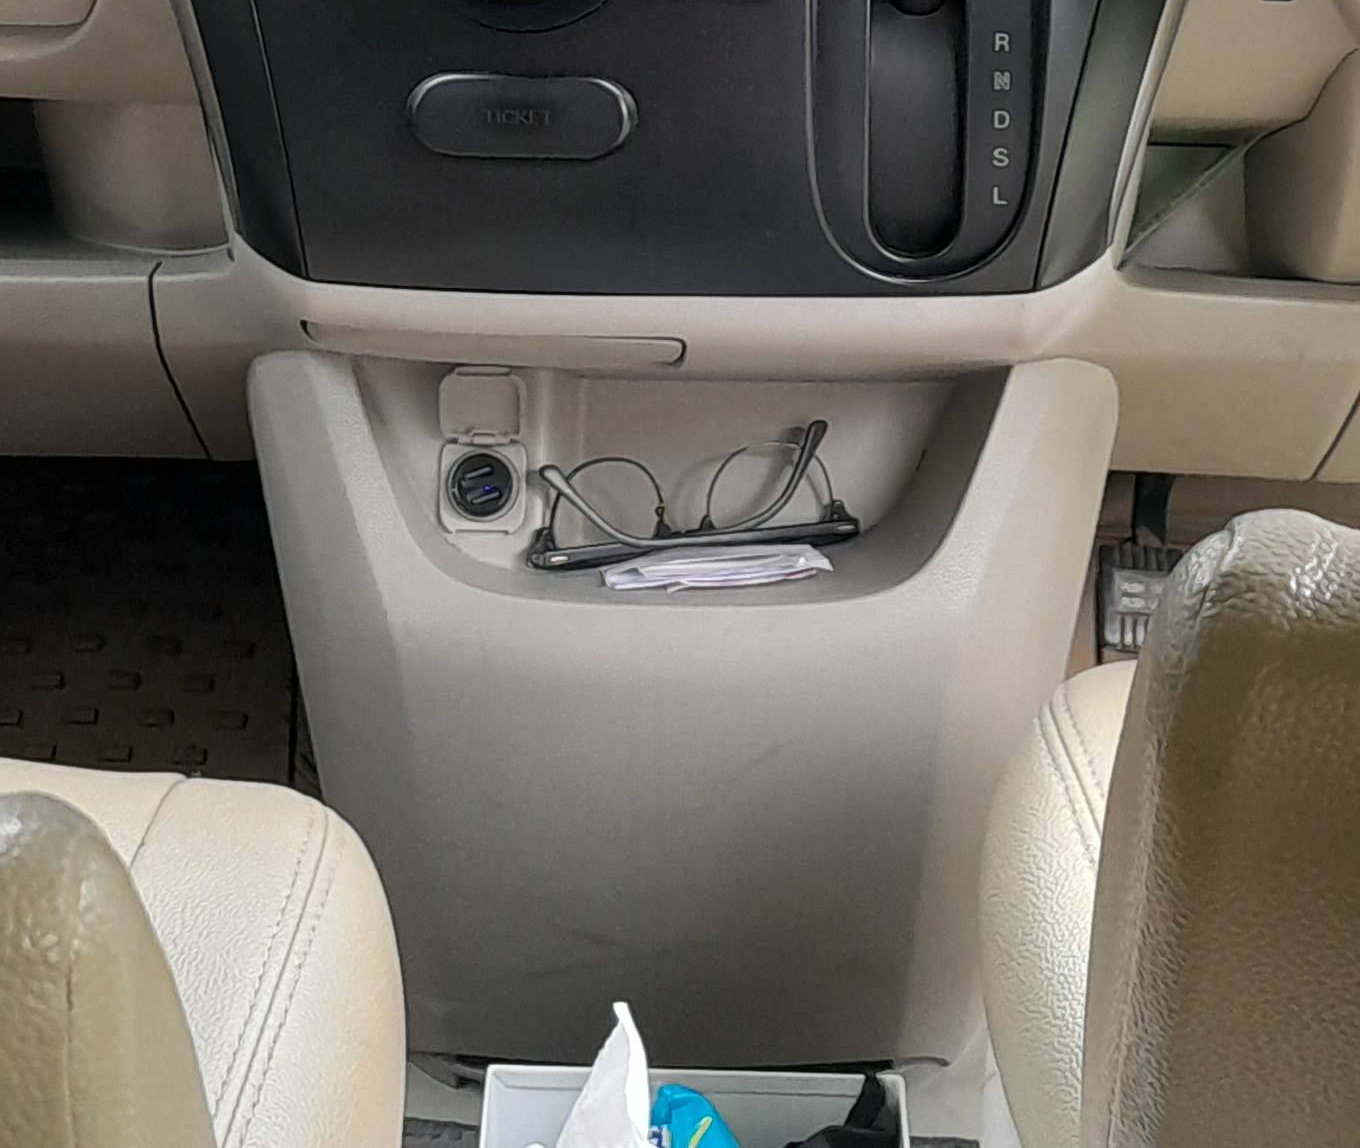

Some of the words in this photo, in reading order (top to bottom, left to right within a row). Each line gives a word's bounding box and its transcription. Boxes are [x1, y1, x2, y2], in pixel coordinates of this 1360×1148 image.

[994, 32, 1010, 52] R
[993, 71, 1011, 91] N
[993, 110, 1010, 129] D
[993, 147, 1010, 167] S
[993, 186, 1009, 205] L
